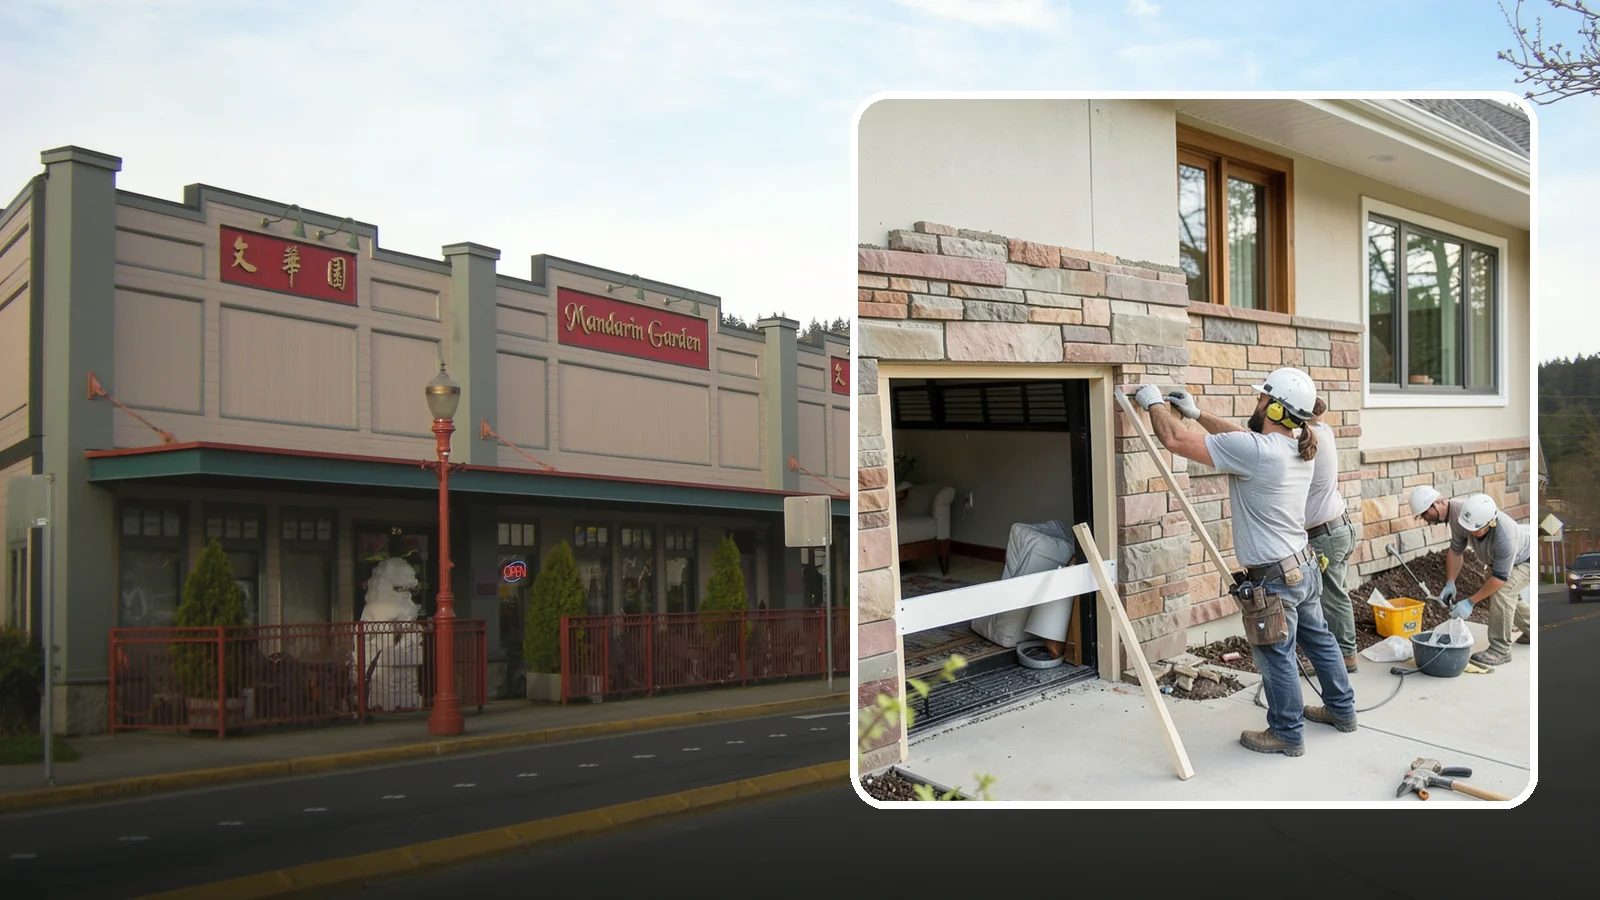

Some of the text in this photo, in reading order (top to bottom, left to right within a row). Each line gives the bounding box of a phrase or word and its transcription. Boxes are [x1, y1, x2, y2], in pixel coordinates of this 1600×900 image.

[231, 236, 346, 290] 文華園
[564, 302, 701, 352] Mandarin Garden
[503, 565, 527, 578] OPEN
